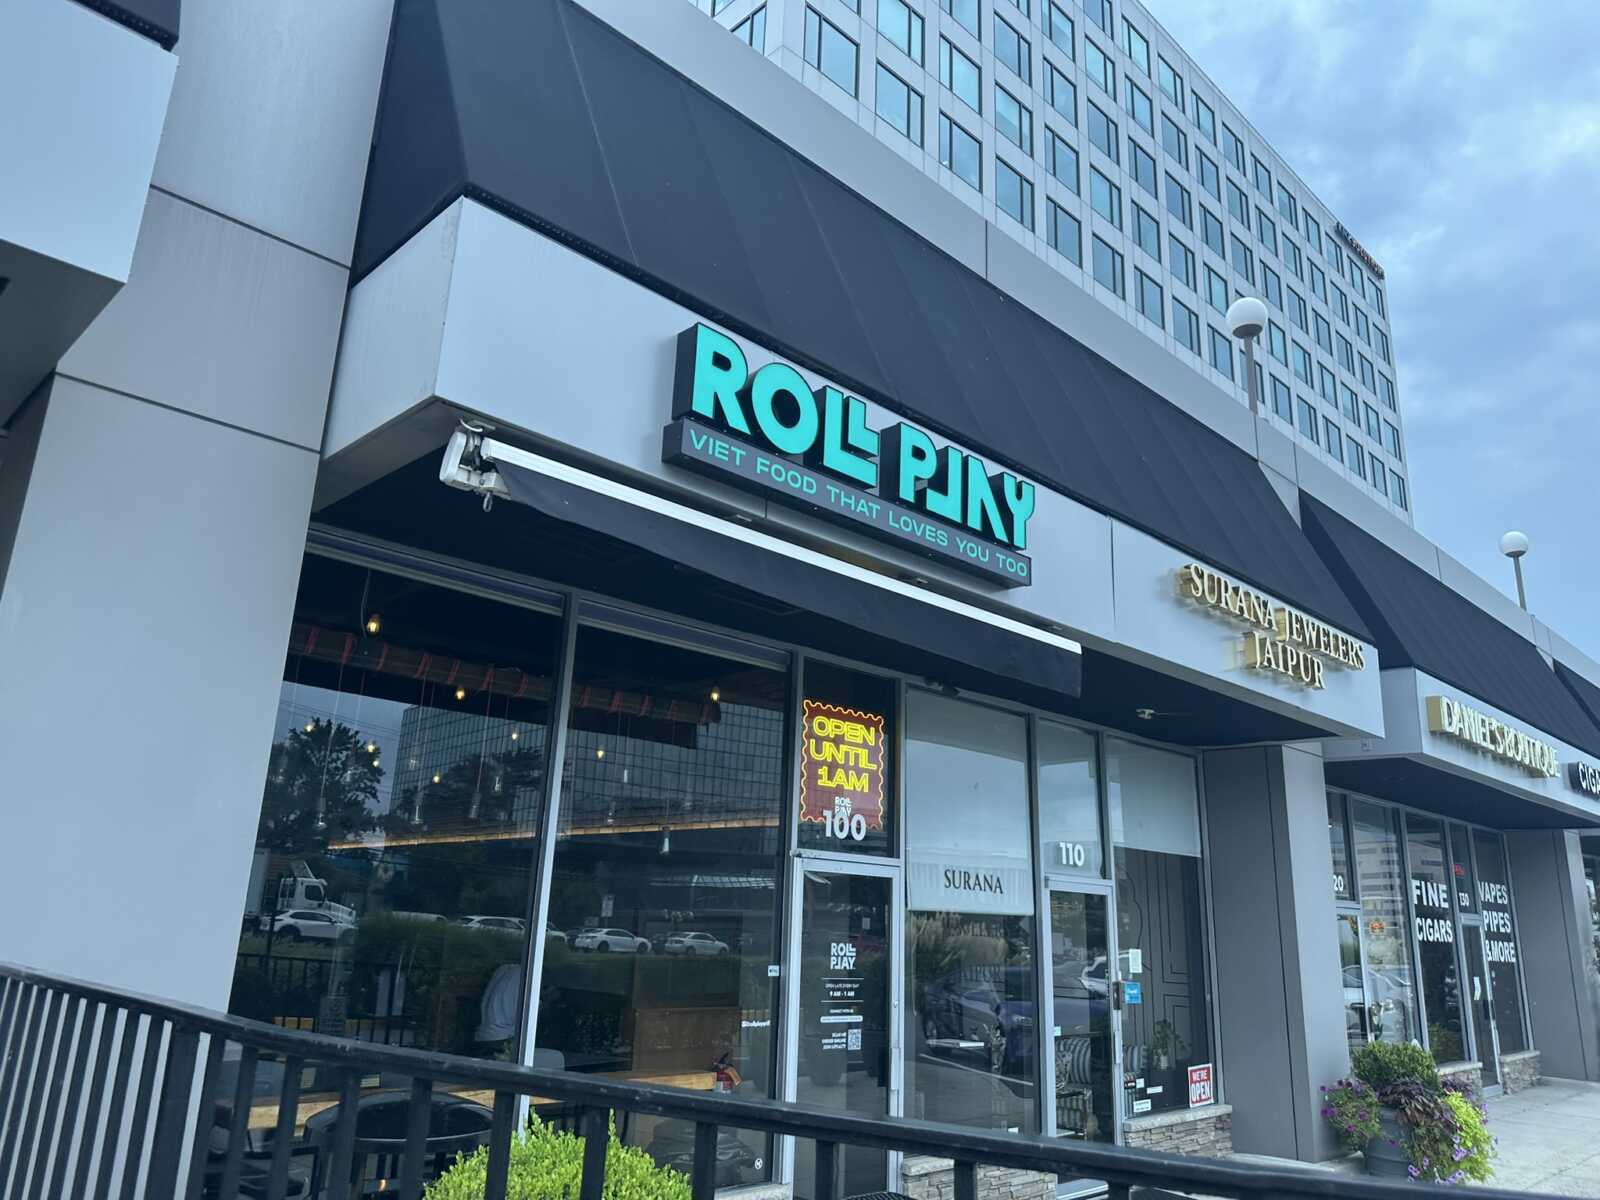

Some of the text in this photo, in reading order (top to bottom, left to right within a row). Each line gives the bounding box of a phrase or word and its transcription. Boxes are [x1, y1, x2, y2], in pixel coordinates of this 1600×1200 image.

[692, 322, 1034, 549] ROLL PLAY
[688, 429, 1028, 577] VIET FOOD THAT LOVES YOU TOO
[1189, 563, 1367, 671] SURANA JEWELERS
[1253, 631, 1327, 690] JAIPUR
[813, 716, 876, 746] OPEN
[1440, 696, 1561, 778] DANIEL'S BOUTIQUE
[810, 738, 877, 770] UNTIL
[818, 766, 869, 793] 1AM
[823, 809, 867, 841] 100
[1059, 842, 1085, 867] 110
[944, 869, 1004, 894] SURANA
[1411, 880, 1450, 909] FINE
[1477, 880, 1508, 905] VAPES
[1416, 917, 1453, 943] CIGARS
[1483, 910, 1511, 934] PIPES
[830, 942, 856, 957] ROLL
[830, 957, 856, 970] PLAY
[1190, 1082, 1211, 1101] OPEN
